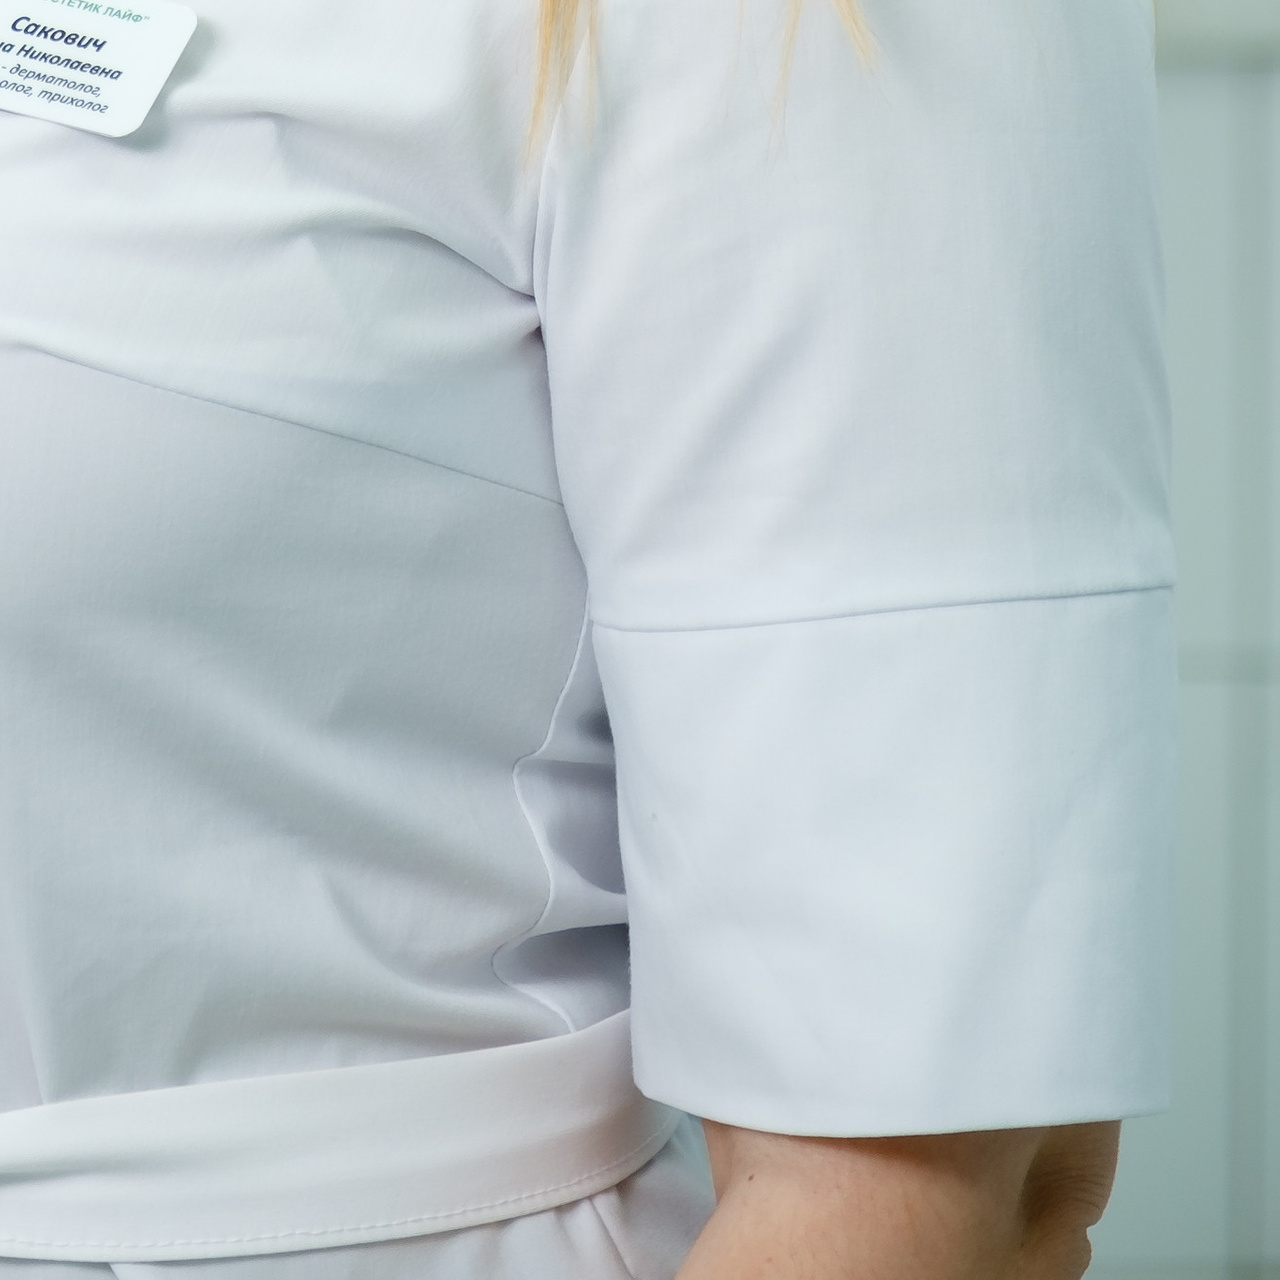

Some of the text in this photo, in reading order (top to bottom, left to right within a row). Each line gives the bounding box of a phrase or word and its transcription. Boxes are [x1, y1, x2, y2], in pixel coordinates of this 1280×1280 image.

[11, 16, 107, 53] Сакович
[16, 44, 123, 80] Николаевна
[9, 63, 101, 98] дерматолог,
[37, 89, 109, 114] трихолог
